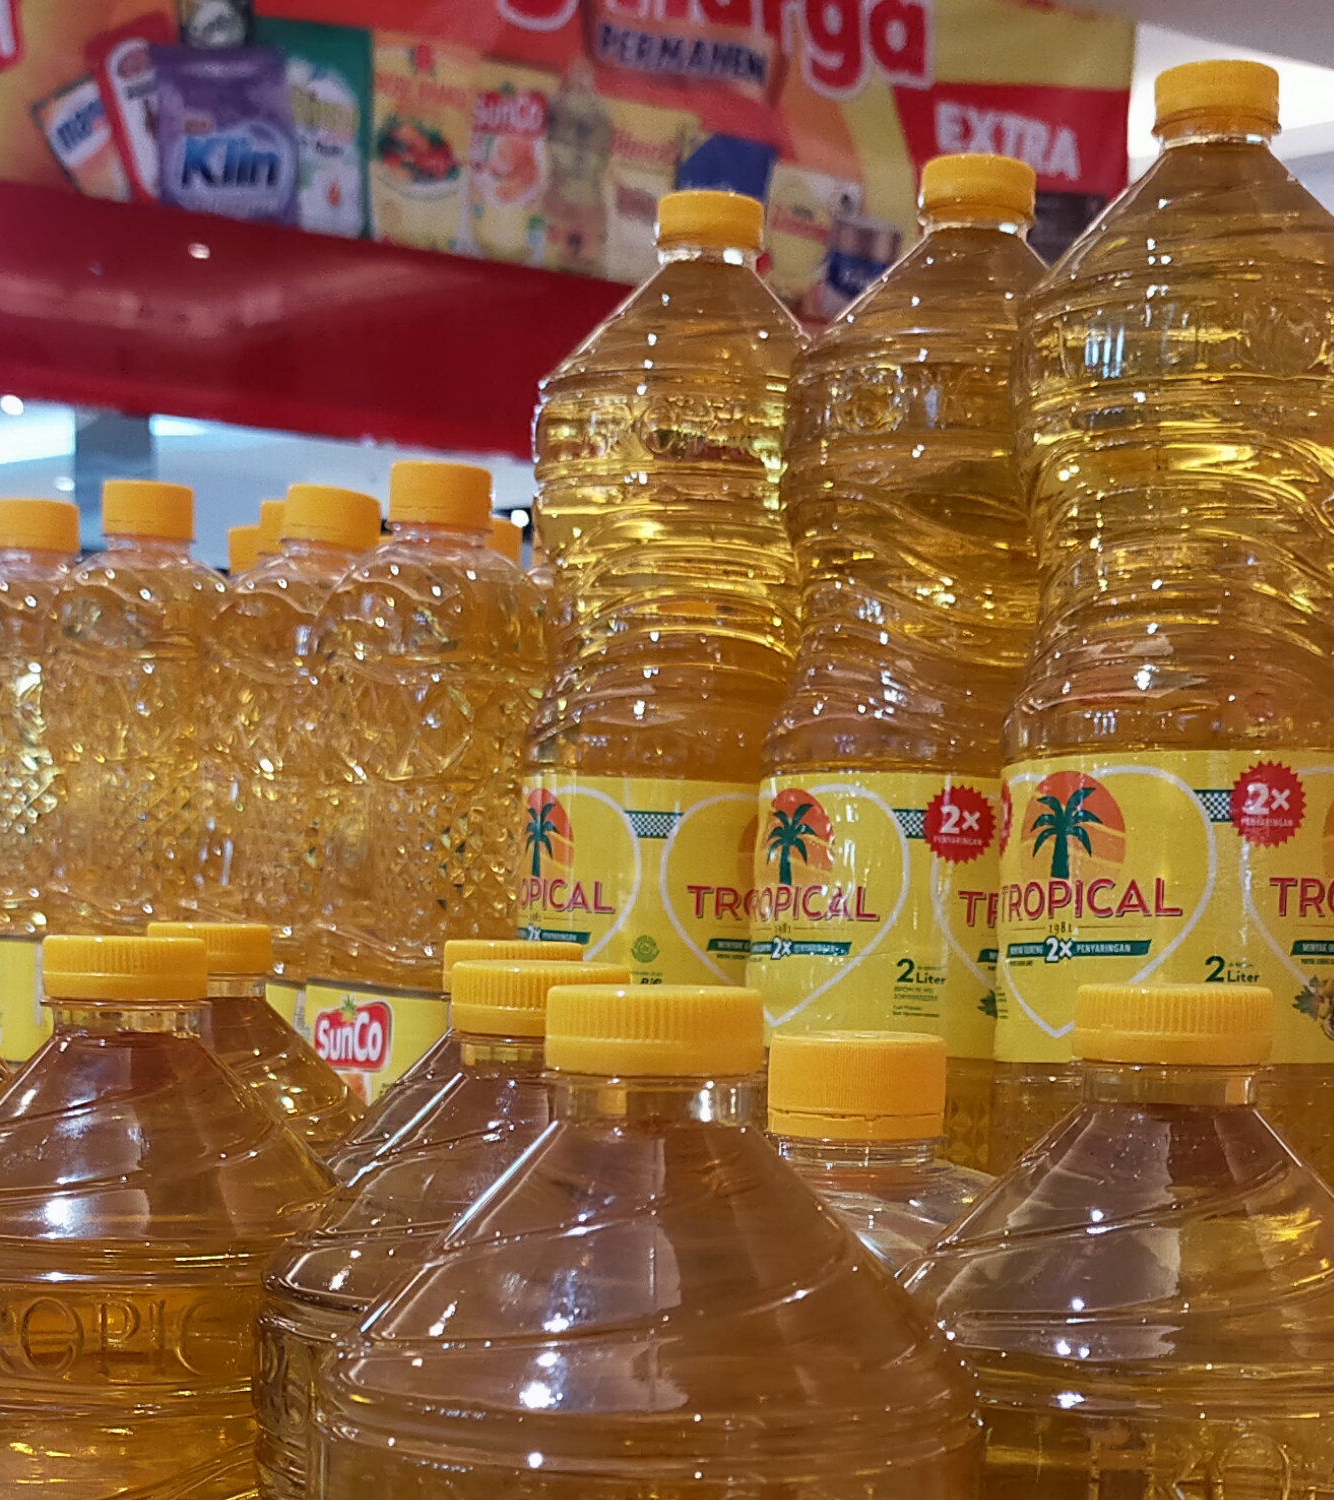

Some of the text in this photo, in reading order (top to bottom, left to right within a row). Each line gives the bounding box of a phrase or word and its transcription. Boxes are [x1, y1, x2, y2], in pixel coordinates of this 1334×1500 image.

[181, 134, 280, 188] Klin
[934, 103, 1080, 181] EXTRA
[1001, 877, 1183, 923] TROPICAL
[317, 1013, 384, 1062] SunCo
